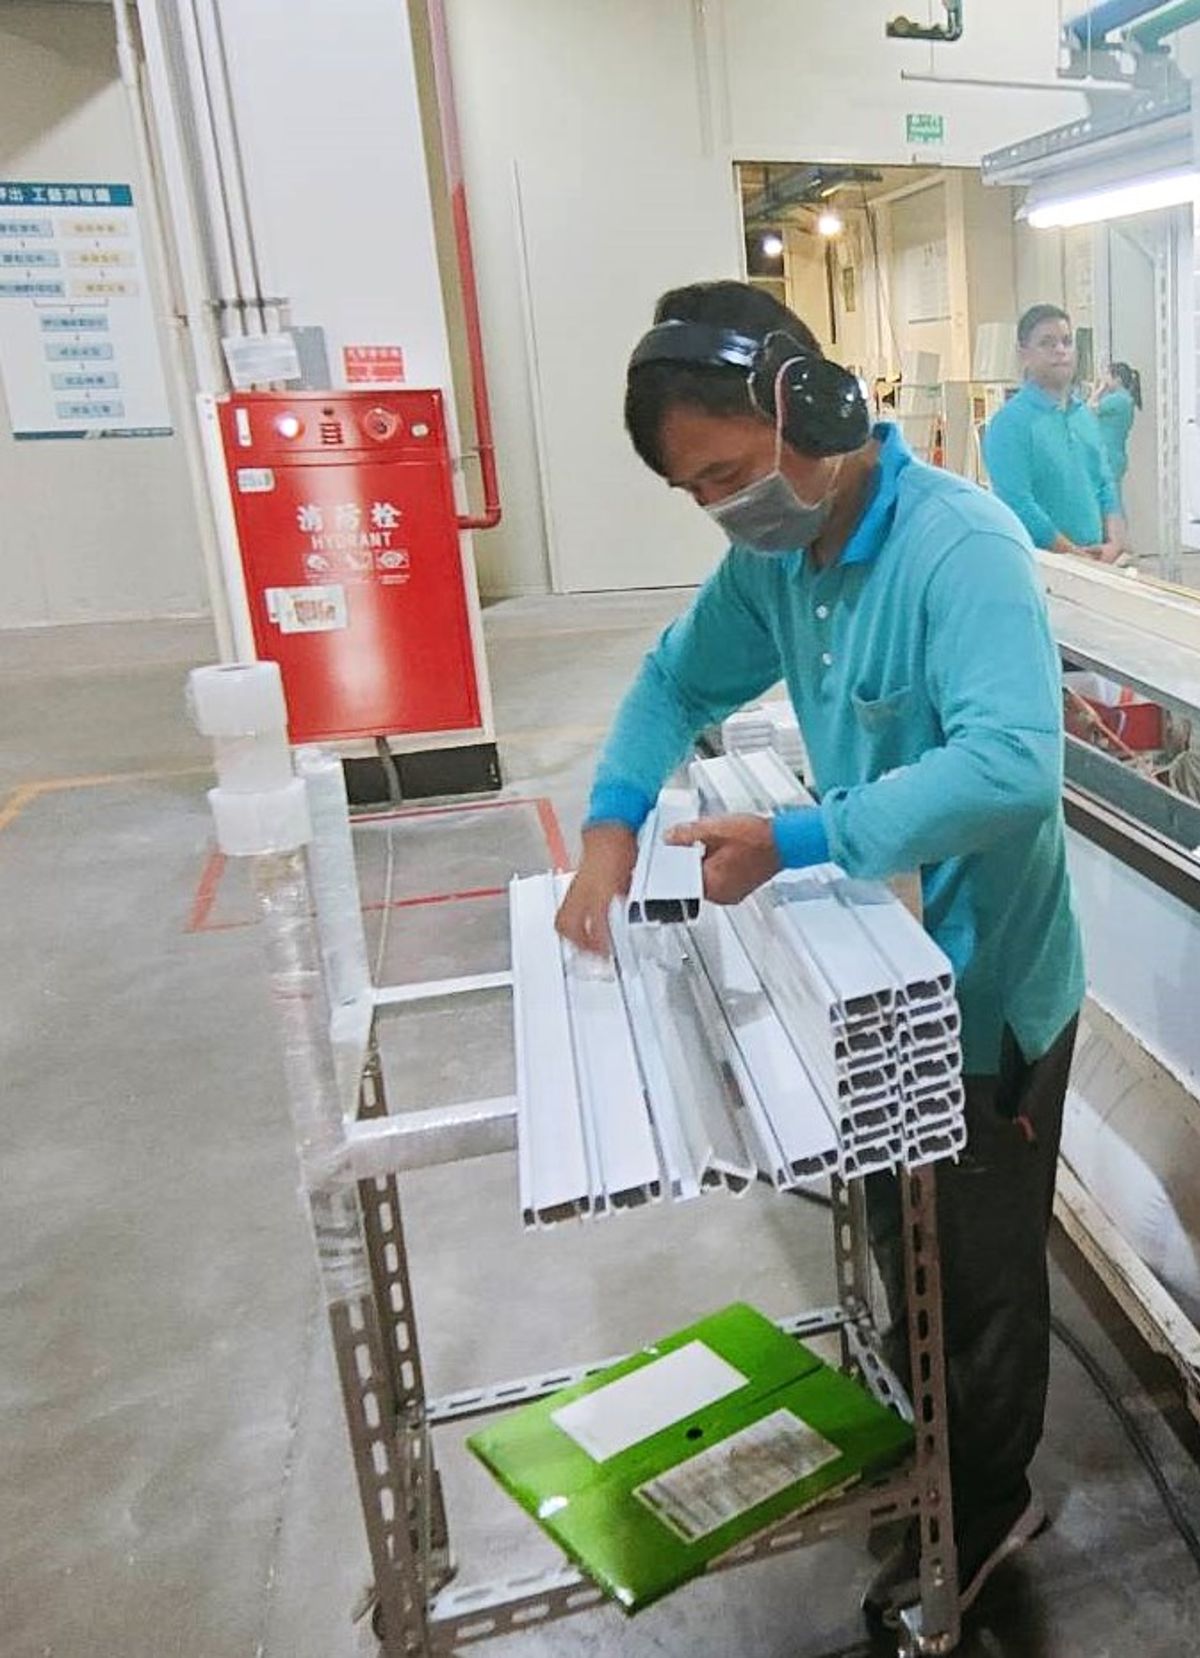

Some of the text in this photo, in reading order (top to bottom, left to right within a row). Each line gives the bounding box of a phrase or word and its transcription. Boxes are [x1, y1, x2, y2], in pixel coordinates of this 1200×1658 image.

[296, 502, 402, 533] 消防栓
[311, 532, 392, 550] HYDRANT
